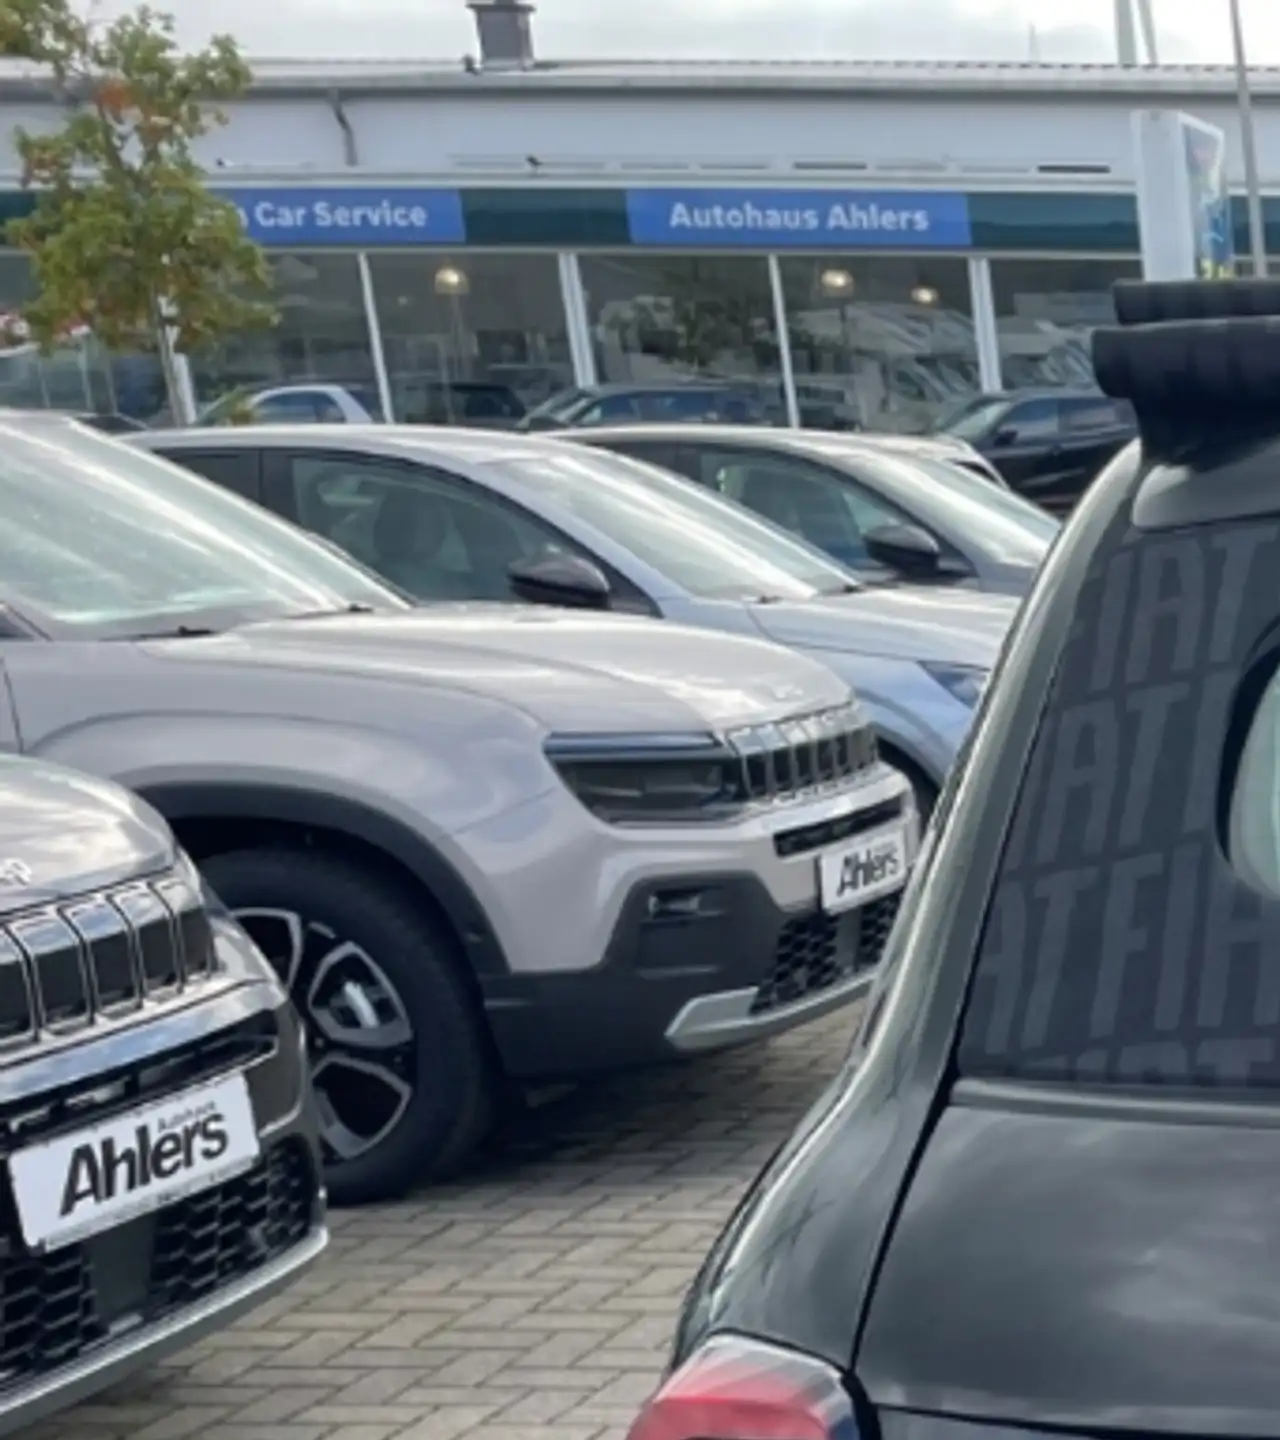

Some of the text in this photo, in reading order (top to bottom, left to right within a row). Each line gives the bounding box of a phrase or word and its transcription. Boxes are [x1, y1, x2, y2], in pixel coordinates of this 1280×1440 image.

[255, 201, 305, 227] Car
[313, 199, 428, 227] Service
[670, 202, 930, 231] Autohaus Ahlers
[59, 1111, 228, 1218] Ahlers
